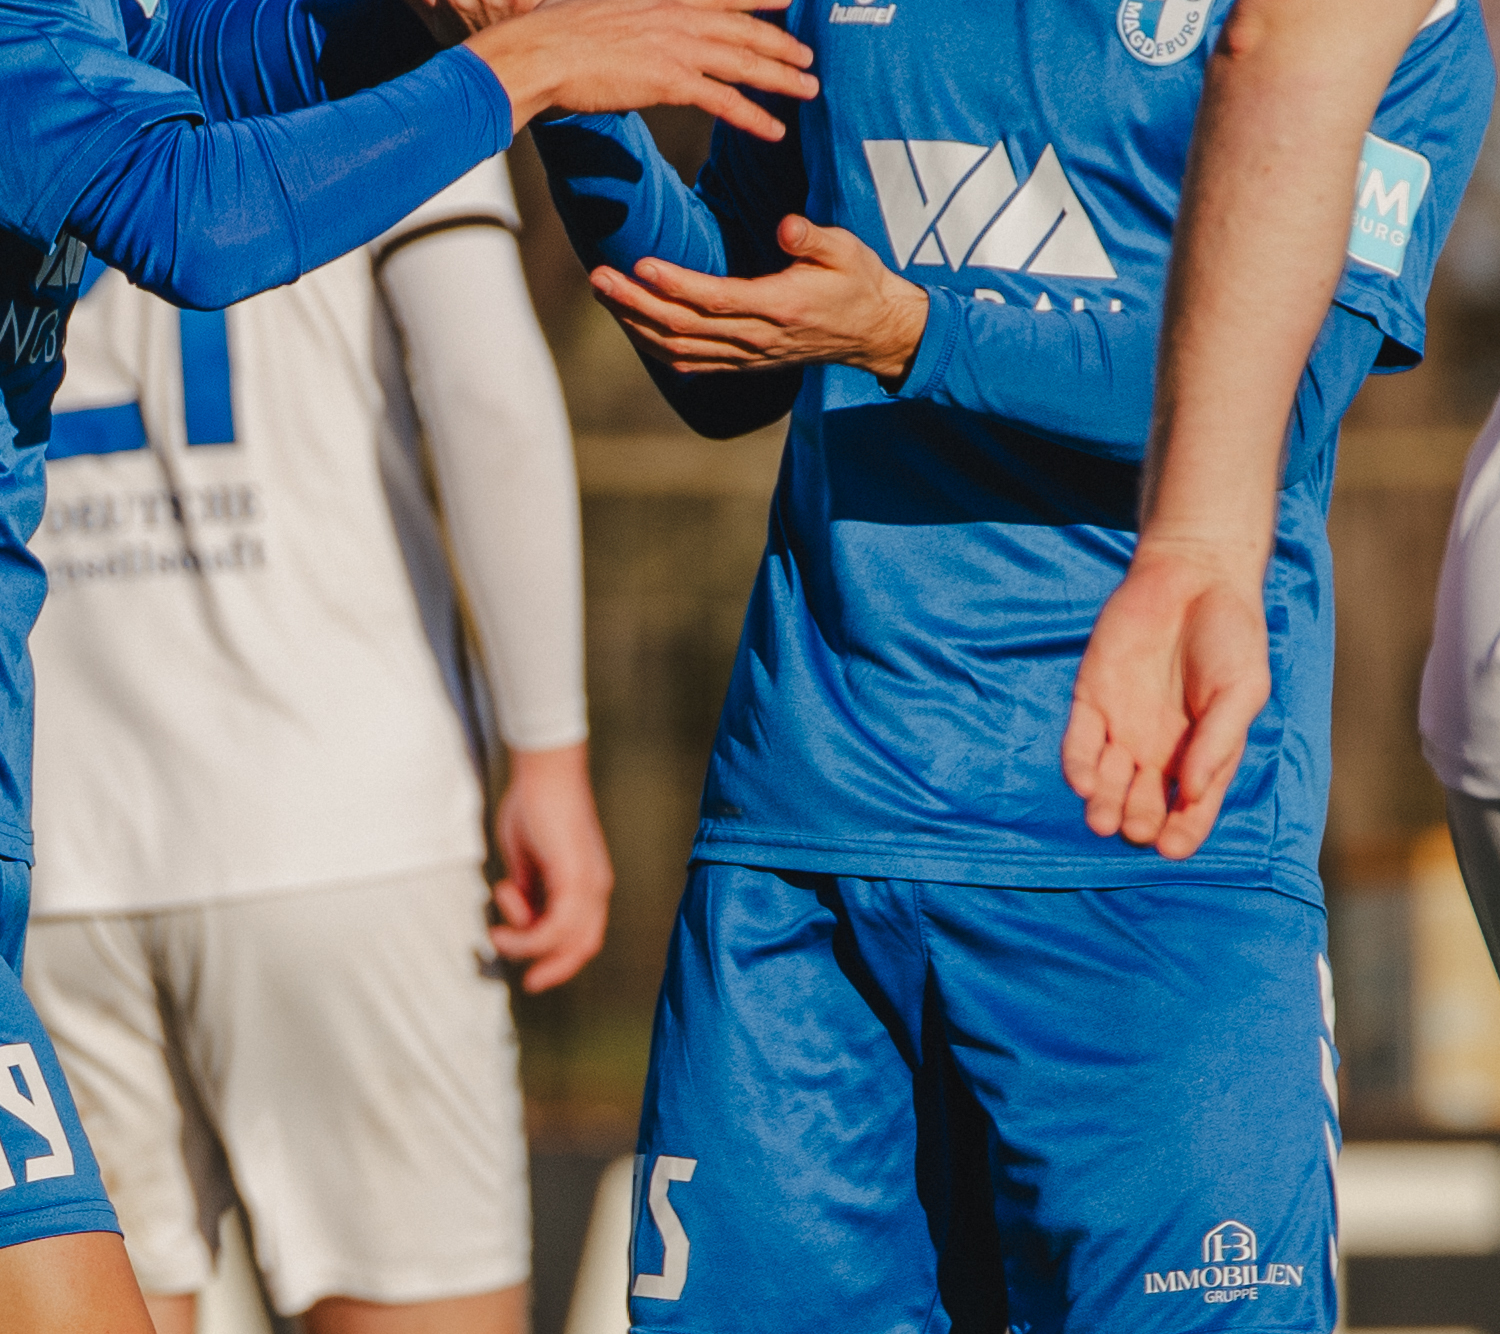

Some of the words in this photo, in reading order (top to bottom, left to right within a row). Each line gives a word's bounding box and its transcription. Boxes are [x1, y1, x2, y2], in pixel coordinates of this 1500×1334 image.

[829, 2, 897, 25] hummel
[1123, 1, 1200, 58] MAGDEBURG
[1144, 1262, 1304, 1294] IMMOBILIEN
[1203, 1287, 1258, 1304] GRUPPE
